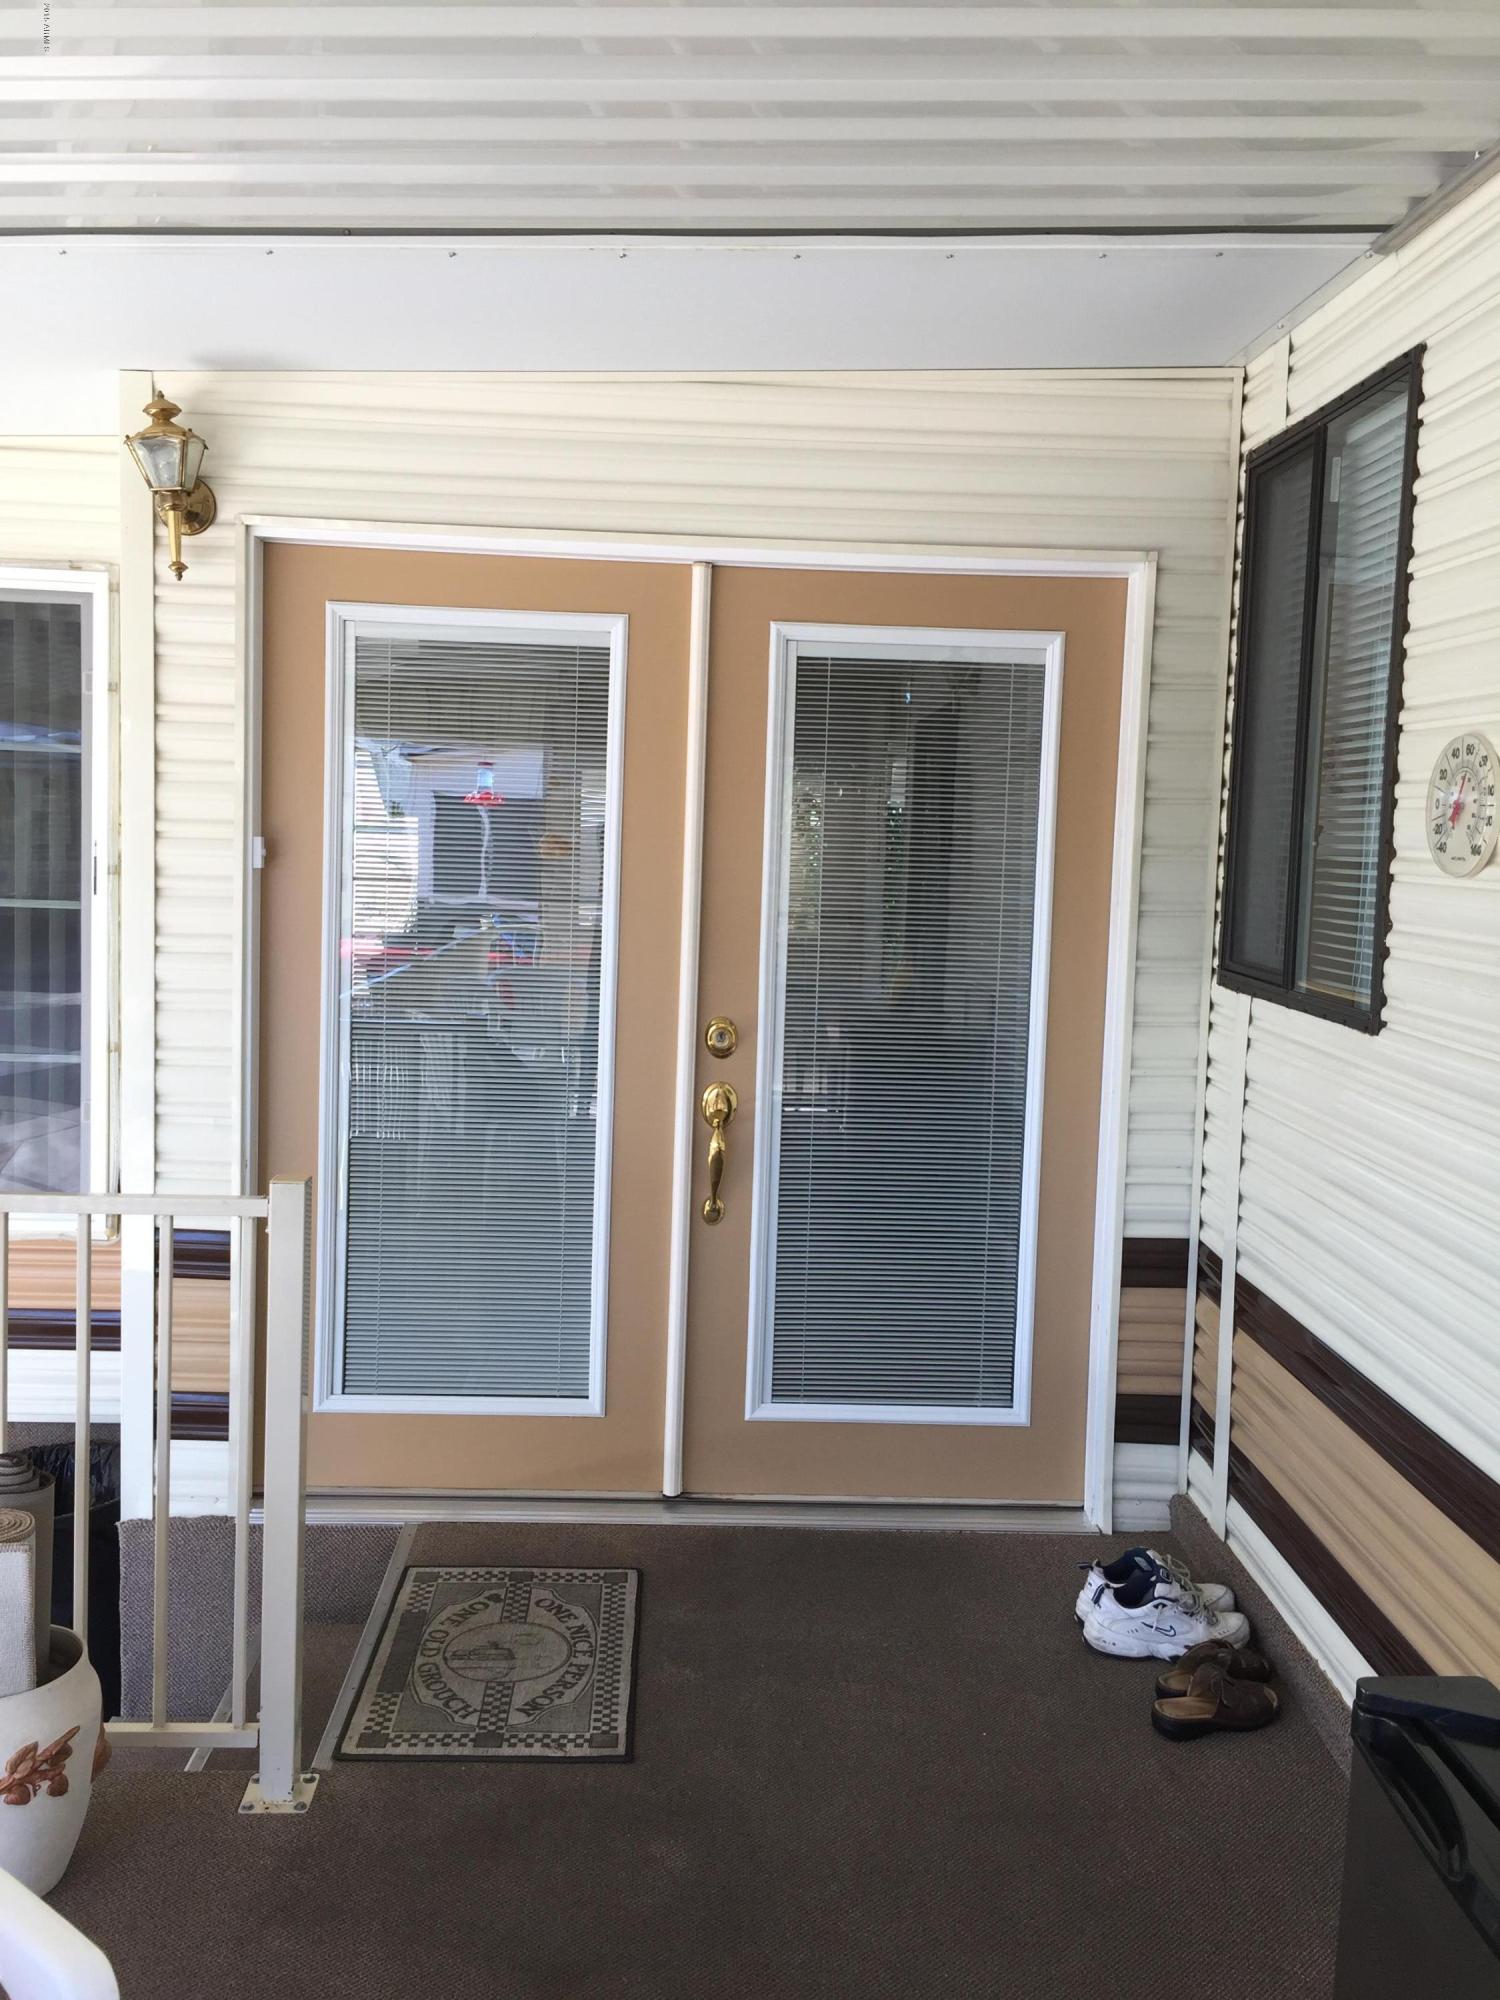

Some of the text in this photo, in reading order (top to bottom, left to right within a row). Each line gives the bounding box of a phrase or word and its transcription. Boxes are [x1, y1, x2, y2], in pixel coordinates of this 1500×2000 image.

[1451, 747, 1460, 760] 40
[1465, 743, 1475, 756] 60
[1439, 768, 1448, 781] 20
[1435, 798, 1440, 810] 0
[418, 1601, 490, 1719] ONE OLD GROUCH
[515, 1598, 595, 1717] ONE NICE PERSON
